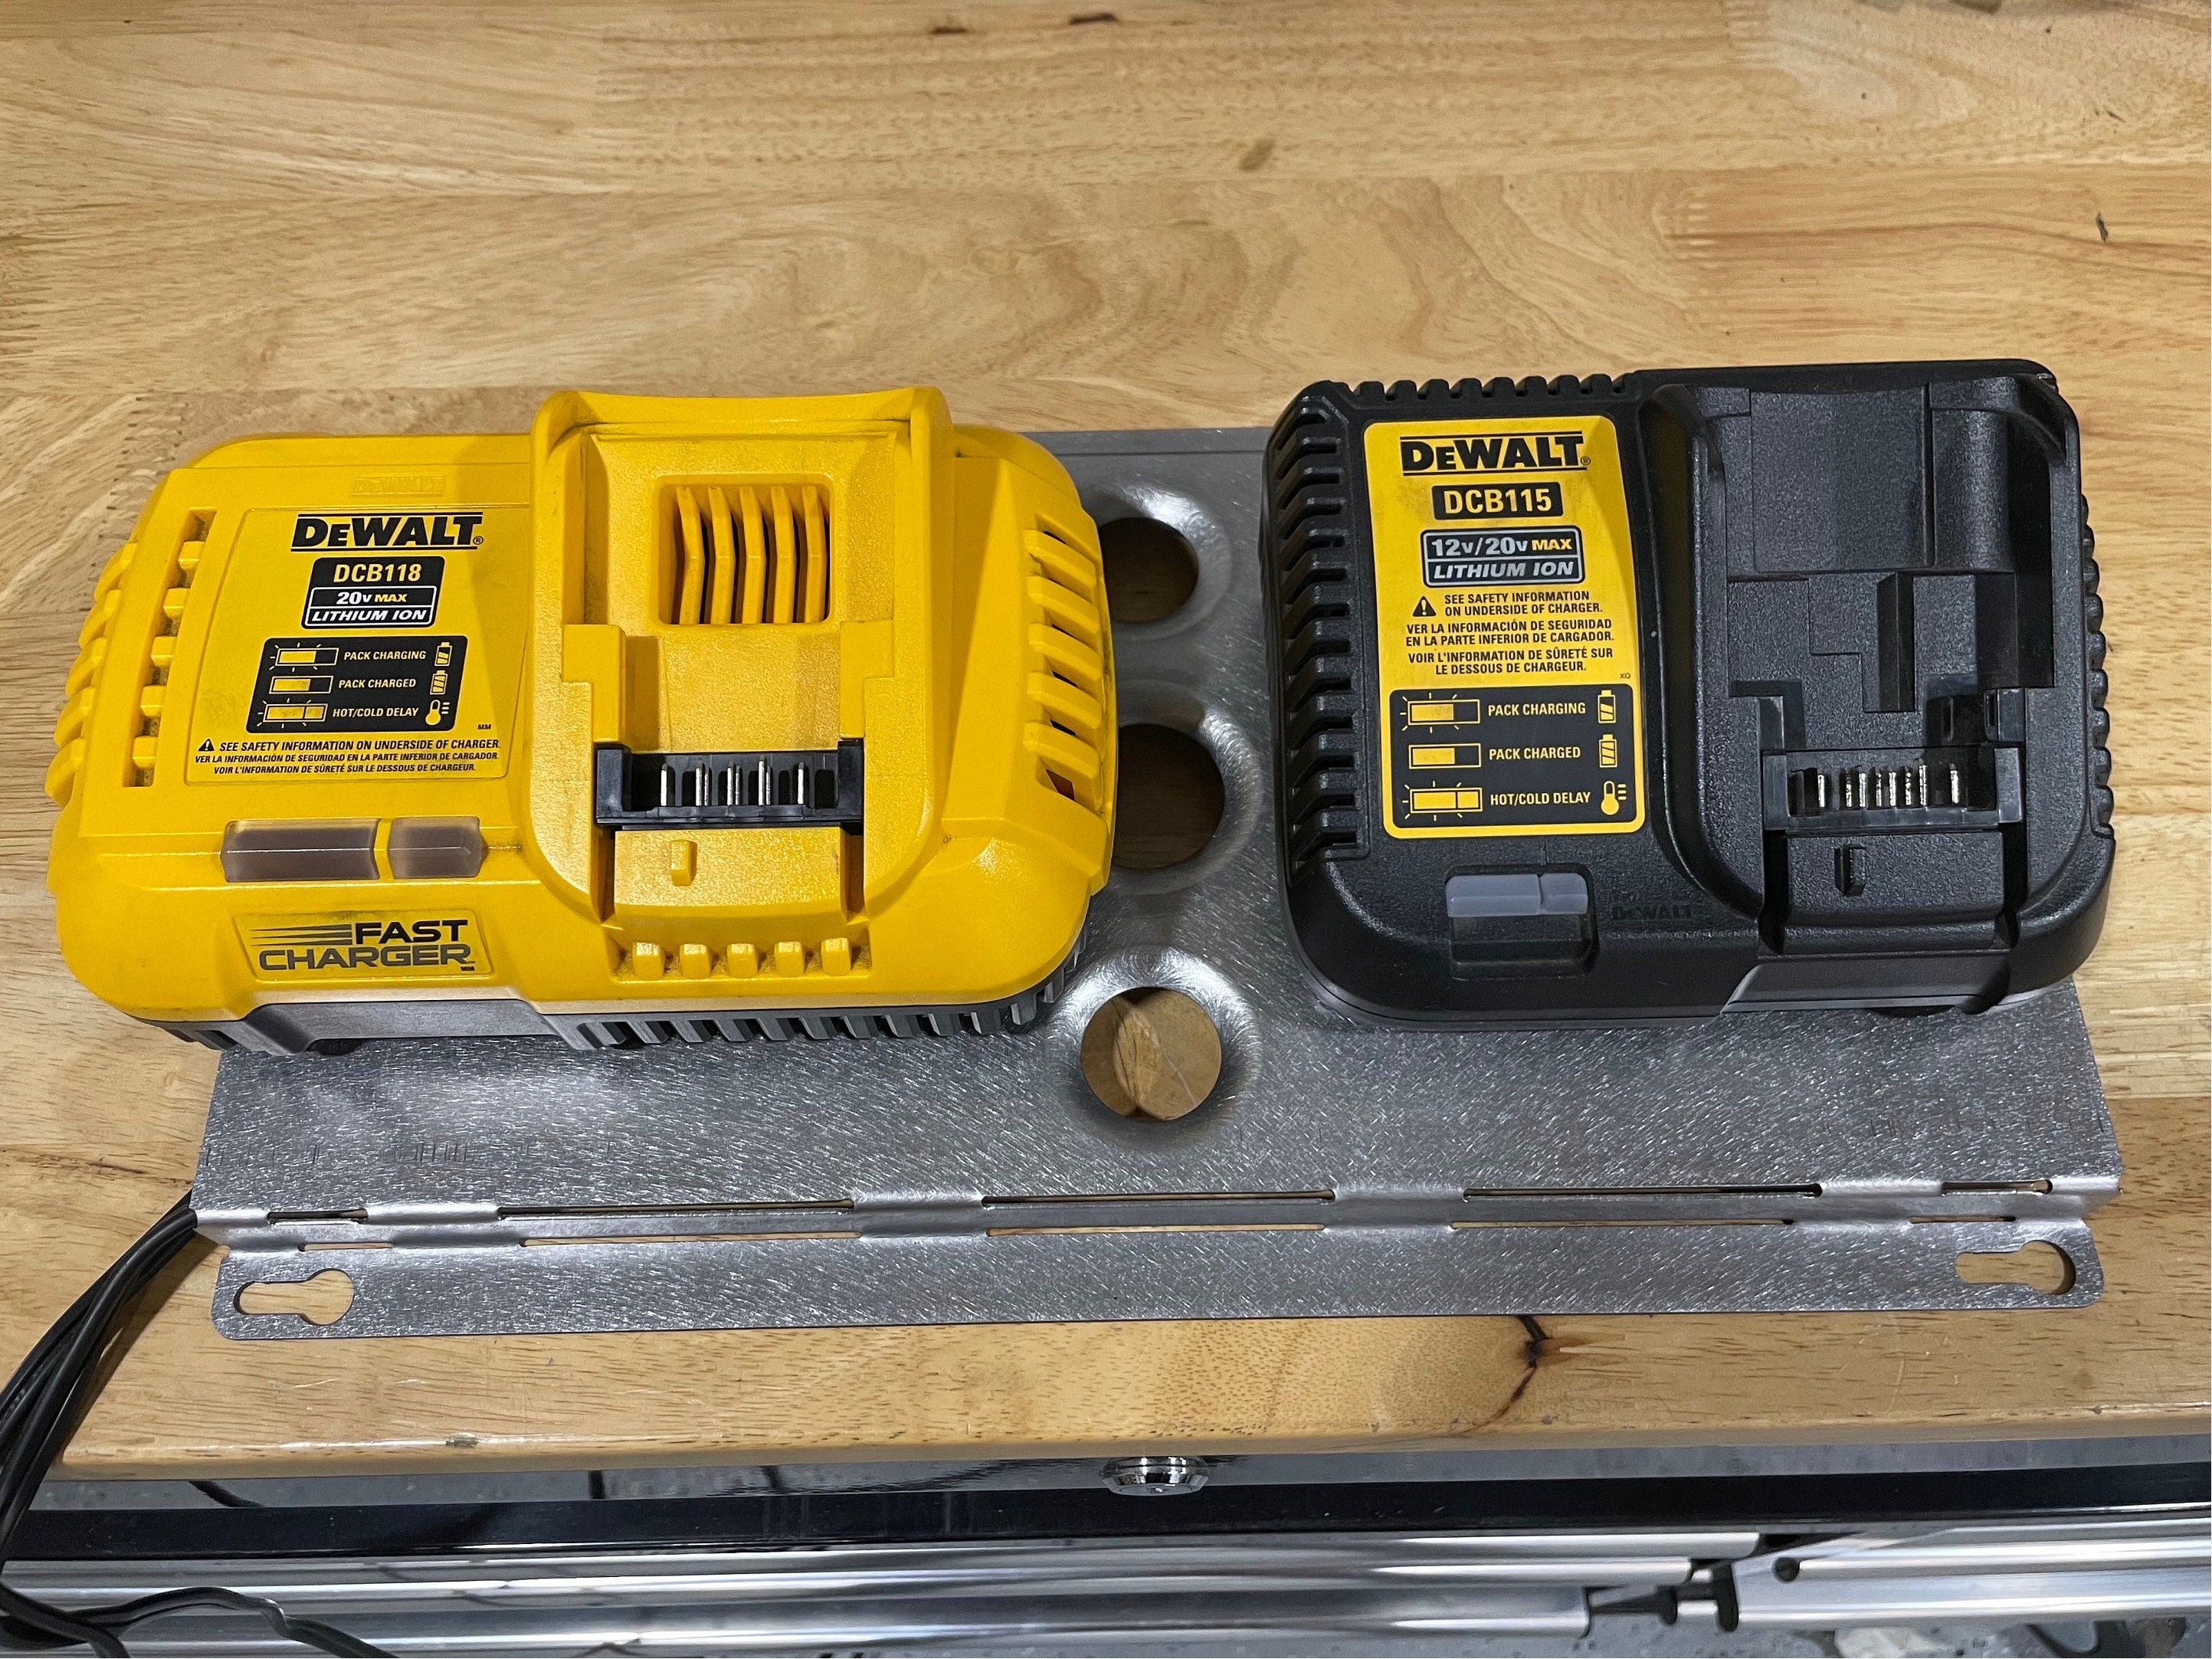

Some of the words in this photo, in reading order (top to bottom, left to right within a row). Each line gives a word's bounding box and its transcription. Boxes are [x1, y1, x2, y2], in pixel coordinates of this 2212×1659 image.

[1444, 489, 1552, 514] DCB115
[1532, 539, 1572, 550] MAX
[333, 564, 422, 583] DCB118
[1434, 562, 1525, 579] LITHIUM
[1533, 562, 1574, 576] ION
[374, 594, 408, 603] MAX
[1444, 595, 1465, 605] SEE
[1468, 593, 1508, 603] SAFETY
[1512, 591, 1590, 602] INFORMATION
[312, 610, 388, 621] LITHIUM
[392, 610, 427, 621] ION
[1445, 606, 1461, 616] ON
[1464, 605, 1529, 615] UNDERSIDE
[1531, 604, 1545, 614] OF
[1548, 602, 1603, 613] CHARGER.
[1407, 624, 1427, 634] VER
[1431, 624, 1444, 634] LA
[1448, 619, 1527, 633] INFORMACIÓN
[1530, 621, 1545, 631] DE
[1548, 618, 1612, 630] SEGURIDAD
[1406, 637, 1421, 647] EN
[1424, 636, 1437, 646] LA
[1441, 634, 1475, 645] PARTE
[1479, 633, 1529, 644] INFERIOR
[1532, 632, 1547, 642] DE
[1550, 631, 1614, 642] CARGADOR.
[343, 651, 370, 661] PACK
[372, 650, 426, 660] CHARGING
[1408, 653, 1434, 664] VOIR
[1438, 651, 1525, 662] L'INFORMATION
[1529, 650, 1542, 661] DE
[1546, 646, 1588, 660] SÛRETÉ
[1591, 648, 1613, 658] SUR
[1436, 664, 1448, 675] LE
[1450, 664, 1503, 674] DESSOUS
[1506, 663, 1521, 673] DE
[1524, 661, 1587, 673] CHARGEUR.
[338, 679, 365, 689] PACK
[367, 678, 416, 688] CHARGED
[333, 707, 383, 718] HOT/COLD
[385, 707, 418, 716] DELAY
[1488, 704, 1519, 716] PACK
[1522, 703, 1586, 714] CHARGING
[219, 742, 238, 752] SEE
[241, 742, 279, 752] SAFETY
[281, 741, 354, 751] INFORMATION
[356, 740, 372, 750] ON
[375, 740, 433, 749] UNDERSIDE
[436, 739, 448, 749] OF
[451, 739, 501, 749] CHARGER.
[224, 753, 283, 762] INFORMACIÓN
[1489, 749, 1521, 760] PACK
[1523, 747, 1581, 759] CHARGED
[234, 766, 300, 774] L'INFORMATION
[314, 763, 345, 773] SÛRETÉ
[1490, 792, 1550, 806] HOT/COLD
[1553, 792, 1591, 804] DELAY
[356, 920, 468, 944] FAST
[259, 944, 471, 970] CHARGER
